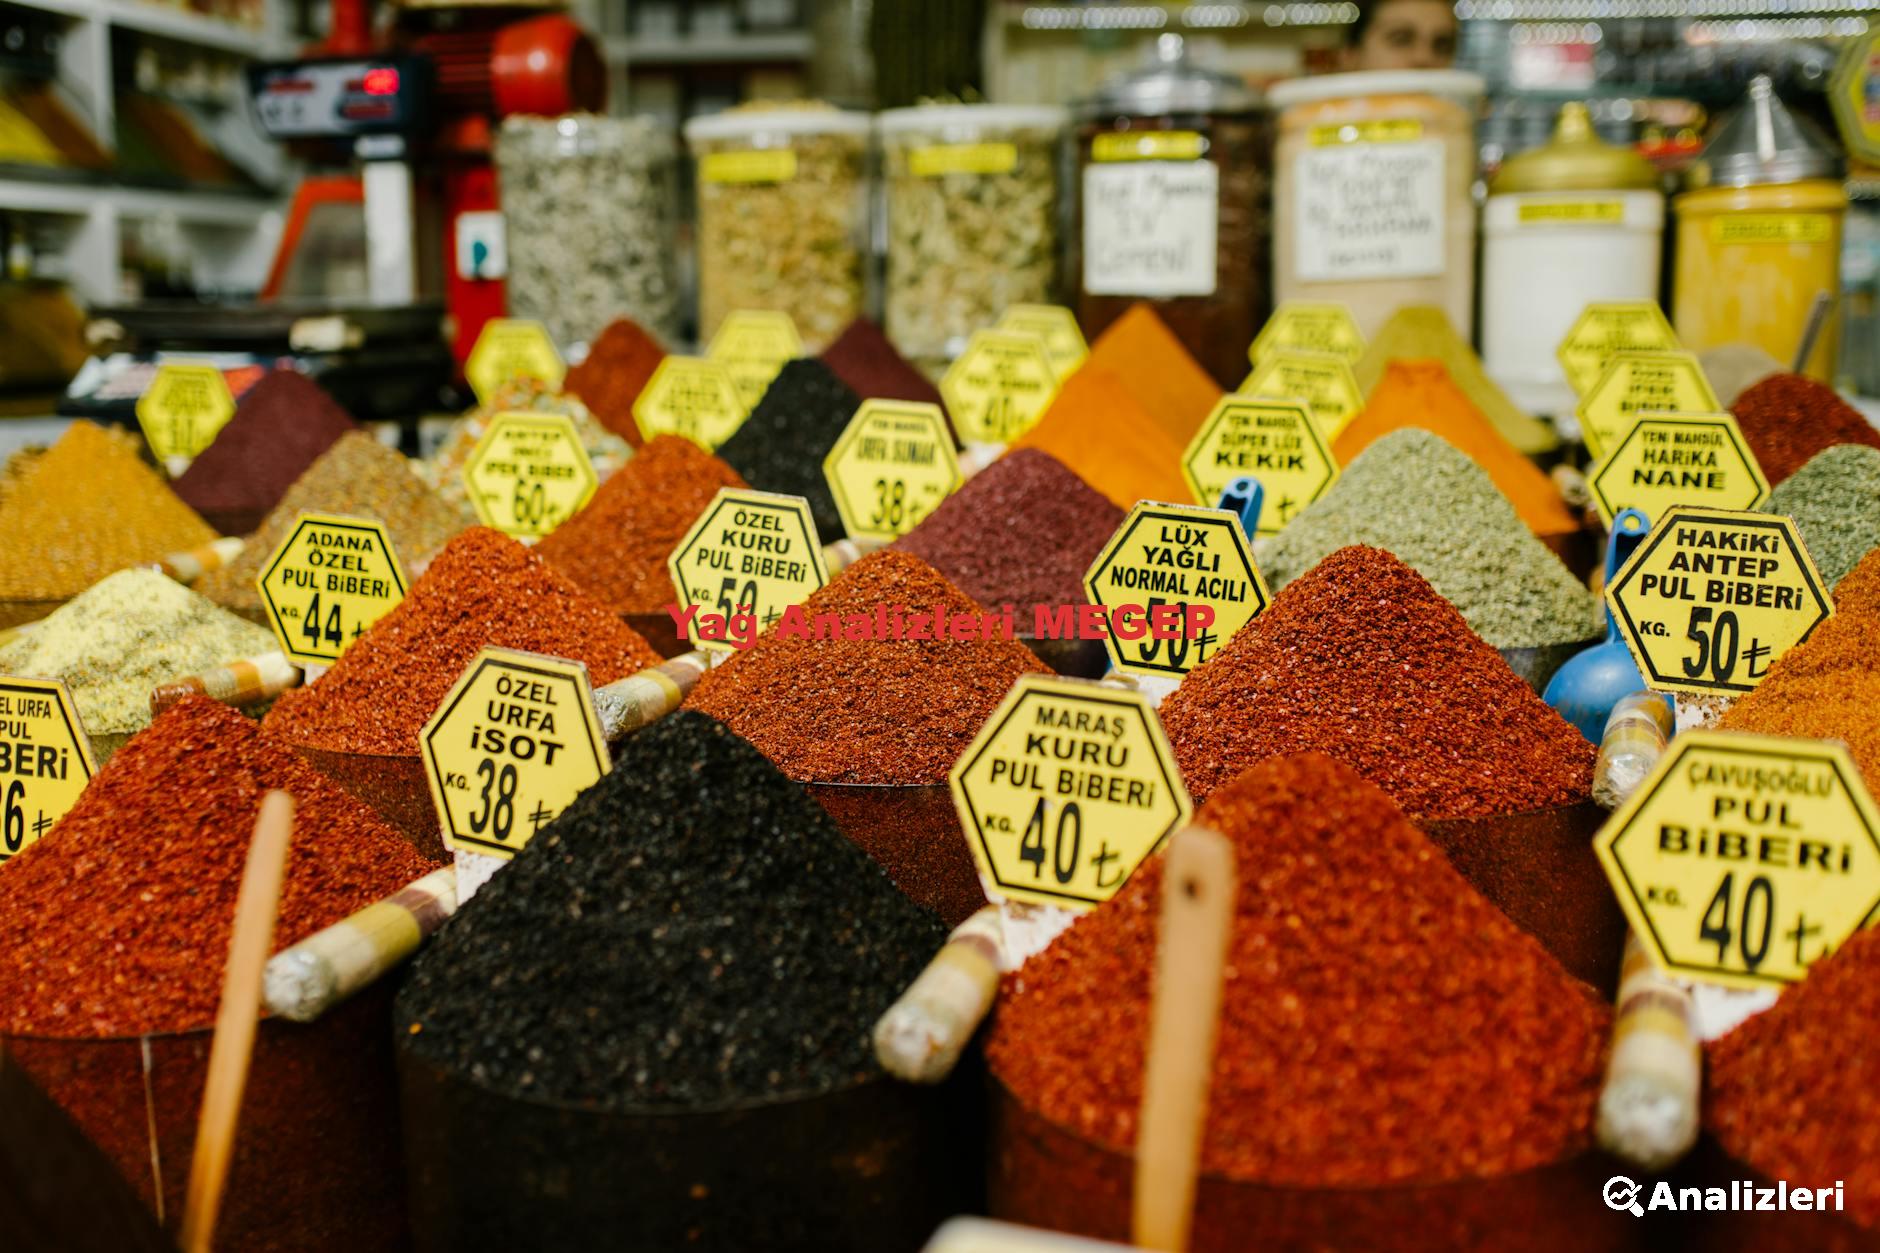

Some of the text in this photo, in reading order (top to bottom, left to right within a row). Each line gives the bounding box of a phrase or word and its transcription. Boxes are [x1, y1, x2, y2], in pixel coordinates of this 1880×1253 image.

[1633, 468, 1725, 490] NANE
[505, 479, 545, 528] 60
[871, 478, 905, 527] 38
[734, 508, 785, 532] ÖZEL
[1160, 524, 1209, 548] LÜX
[307, 532, 373, 552] ADANA
[696, 547, 734, 571] PUL
[722, 529, 791, 555] KURU
[1142, 545, 1221, 573] YAĞLI
[308, 548, 369, 573] ÖZEL
[1667, 551, 1780, 579] ANTEP
[283, 568, 319, 589] PUL
[1110, 565, 1247, 603] NORMAL ACILI
[1640, 573, 1696, 602] PUL
[303, 592, 343, 648] 44
[1639, 620, 1671, 638] KG.
[1682, 606, 1739, 682] 50
[496, 671, 558, 706] ÖZEL
[17, 698, 52, 719] URFA
[488, 700, 556, 734] URFA
[1035, 706, 1126, 742] MARAŞ
[1026, 732, 1128, 768] KURU
[990, 758, 1045, 791] PUL
[1688, 762, 1834, 798] ÇAVUŞOĞLU
[0, 779, 26, 853] 6
[469, 757, 518, 841] 38
[1713, 796, 1803, 830] PUL
[1019, 796, 1082, 885] 40
[1700, 871, 1774, 973] 40
